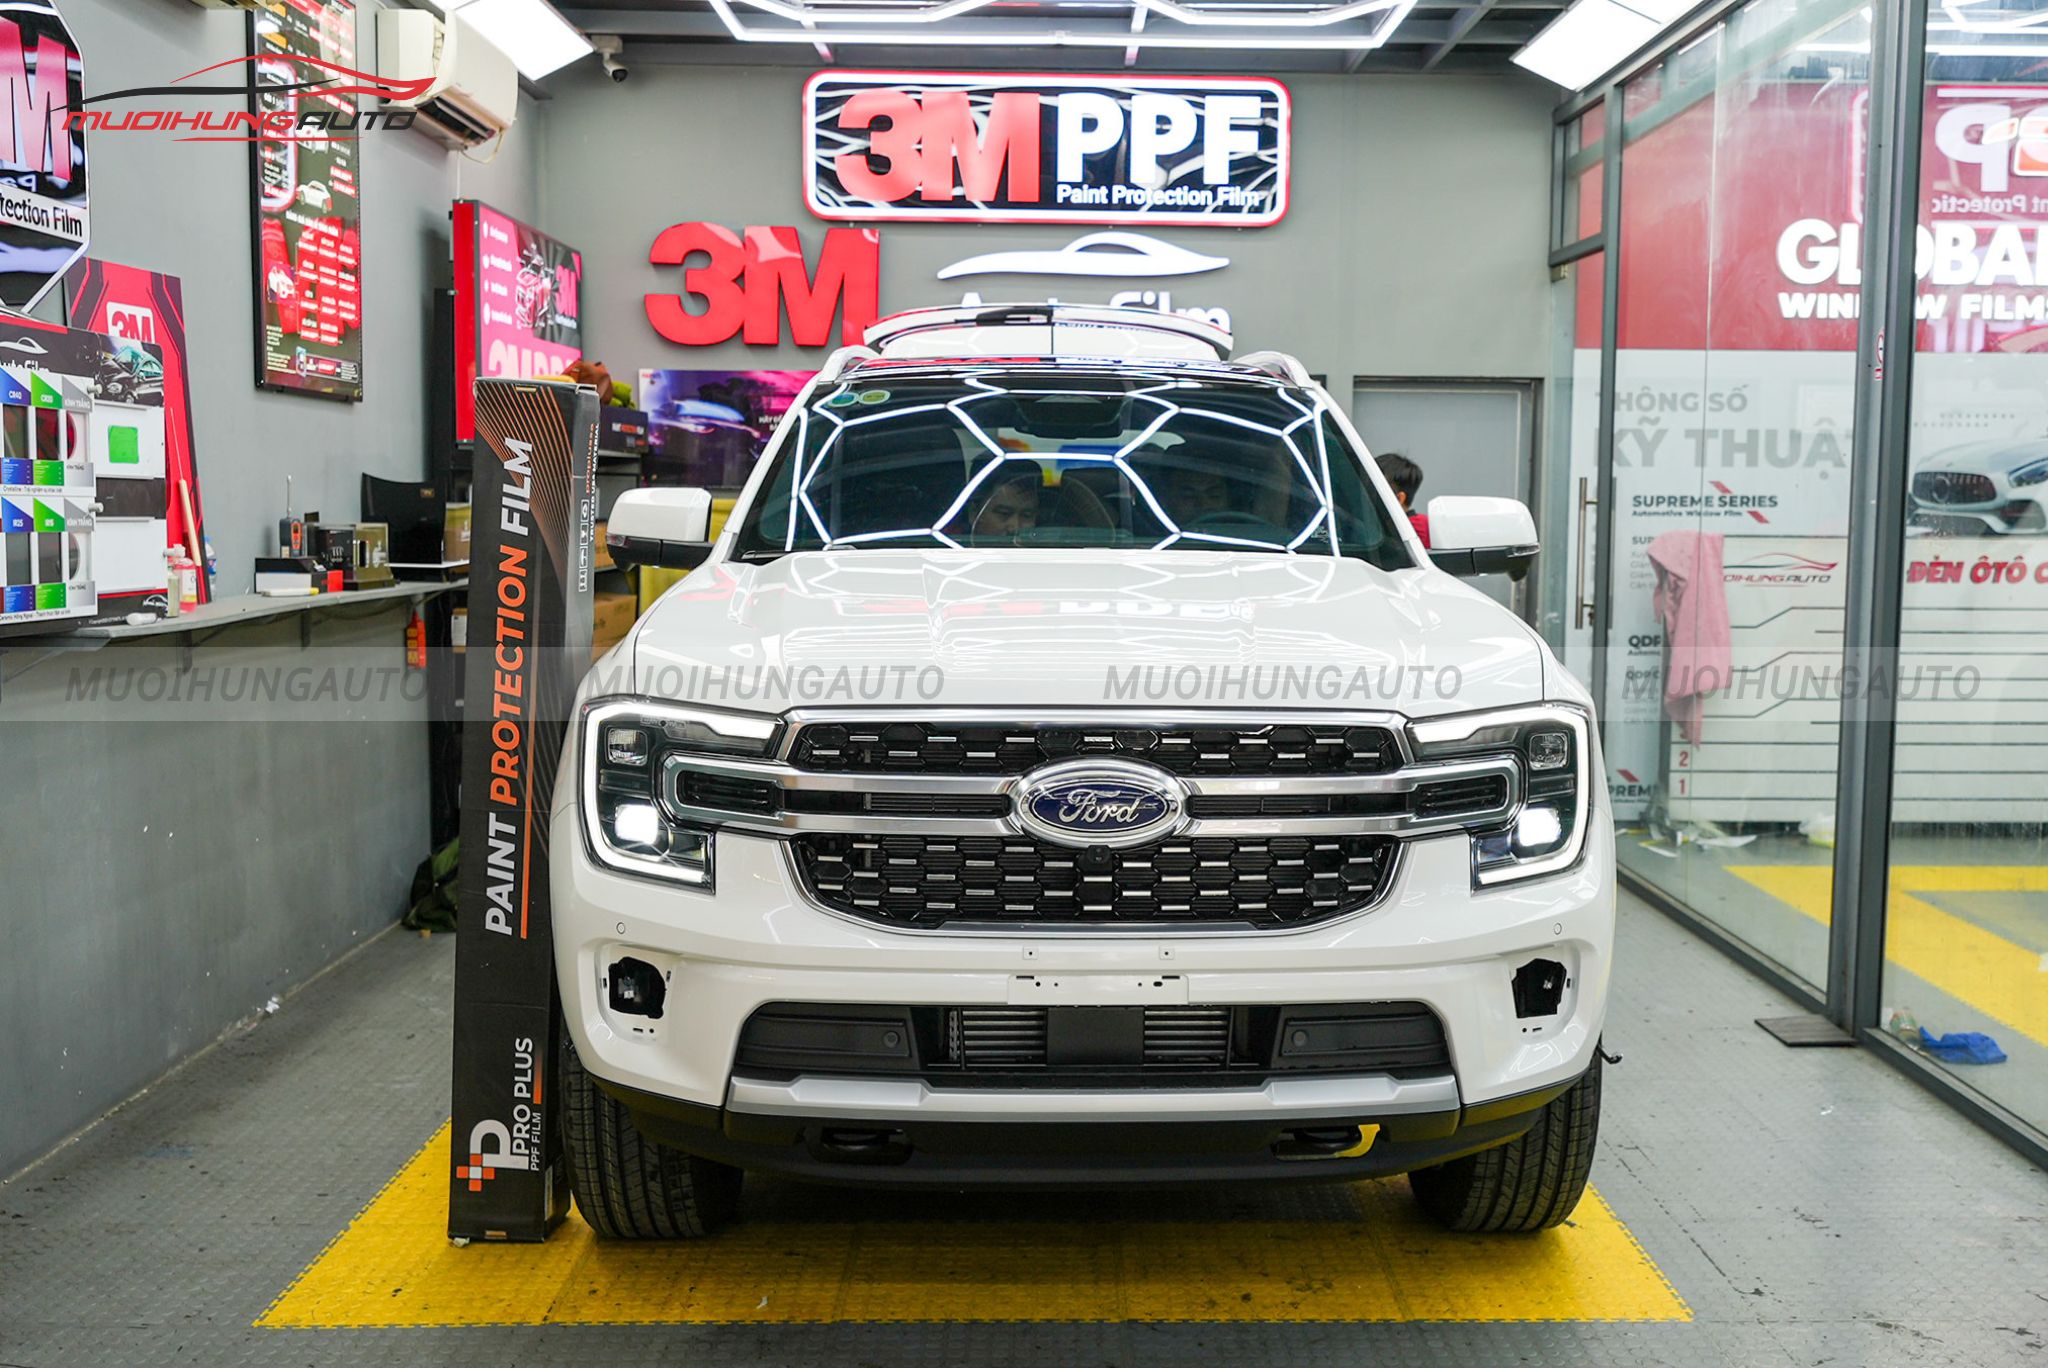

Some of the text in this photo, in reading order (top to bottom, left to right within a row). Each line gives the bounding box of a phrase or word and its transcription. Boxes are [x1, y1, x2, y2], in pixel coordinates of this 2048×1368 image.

[834, 89, 1262, 202] 3M PPF
[1056, 184, 1260, 207] Paint Protection Film
[53, 207, 83, 237] Film
[1776, 219, 2048, 286] GLBA
[644, 222, 880, 346] 3M
[1778, 293, 2048, 320] WINW FILM
[1708, 384, 1750, 412] SỐ
[1685, 416, 1852, 480] THUẬ
[1632, 494, 1778, 508] SUPREME SERIES
[1722, 574, 1831, 583] OIHUNGAUTO
[1969, 554, 2027, 584] ÔTÔ
[485, 437, 533, 936] PAINT PROTECTION FILM
[1679, 751, 1689, 767] 2
[1679, 779, 1686, 795] 1
[1059, 788, 1142, 823] Ford
[512, 1037, 533, 1155] PRO PLUS
[530, 1112, 541, 1171] PPF FILM
